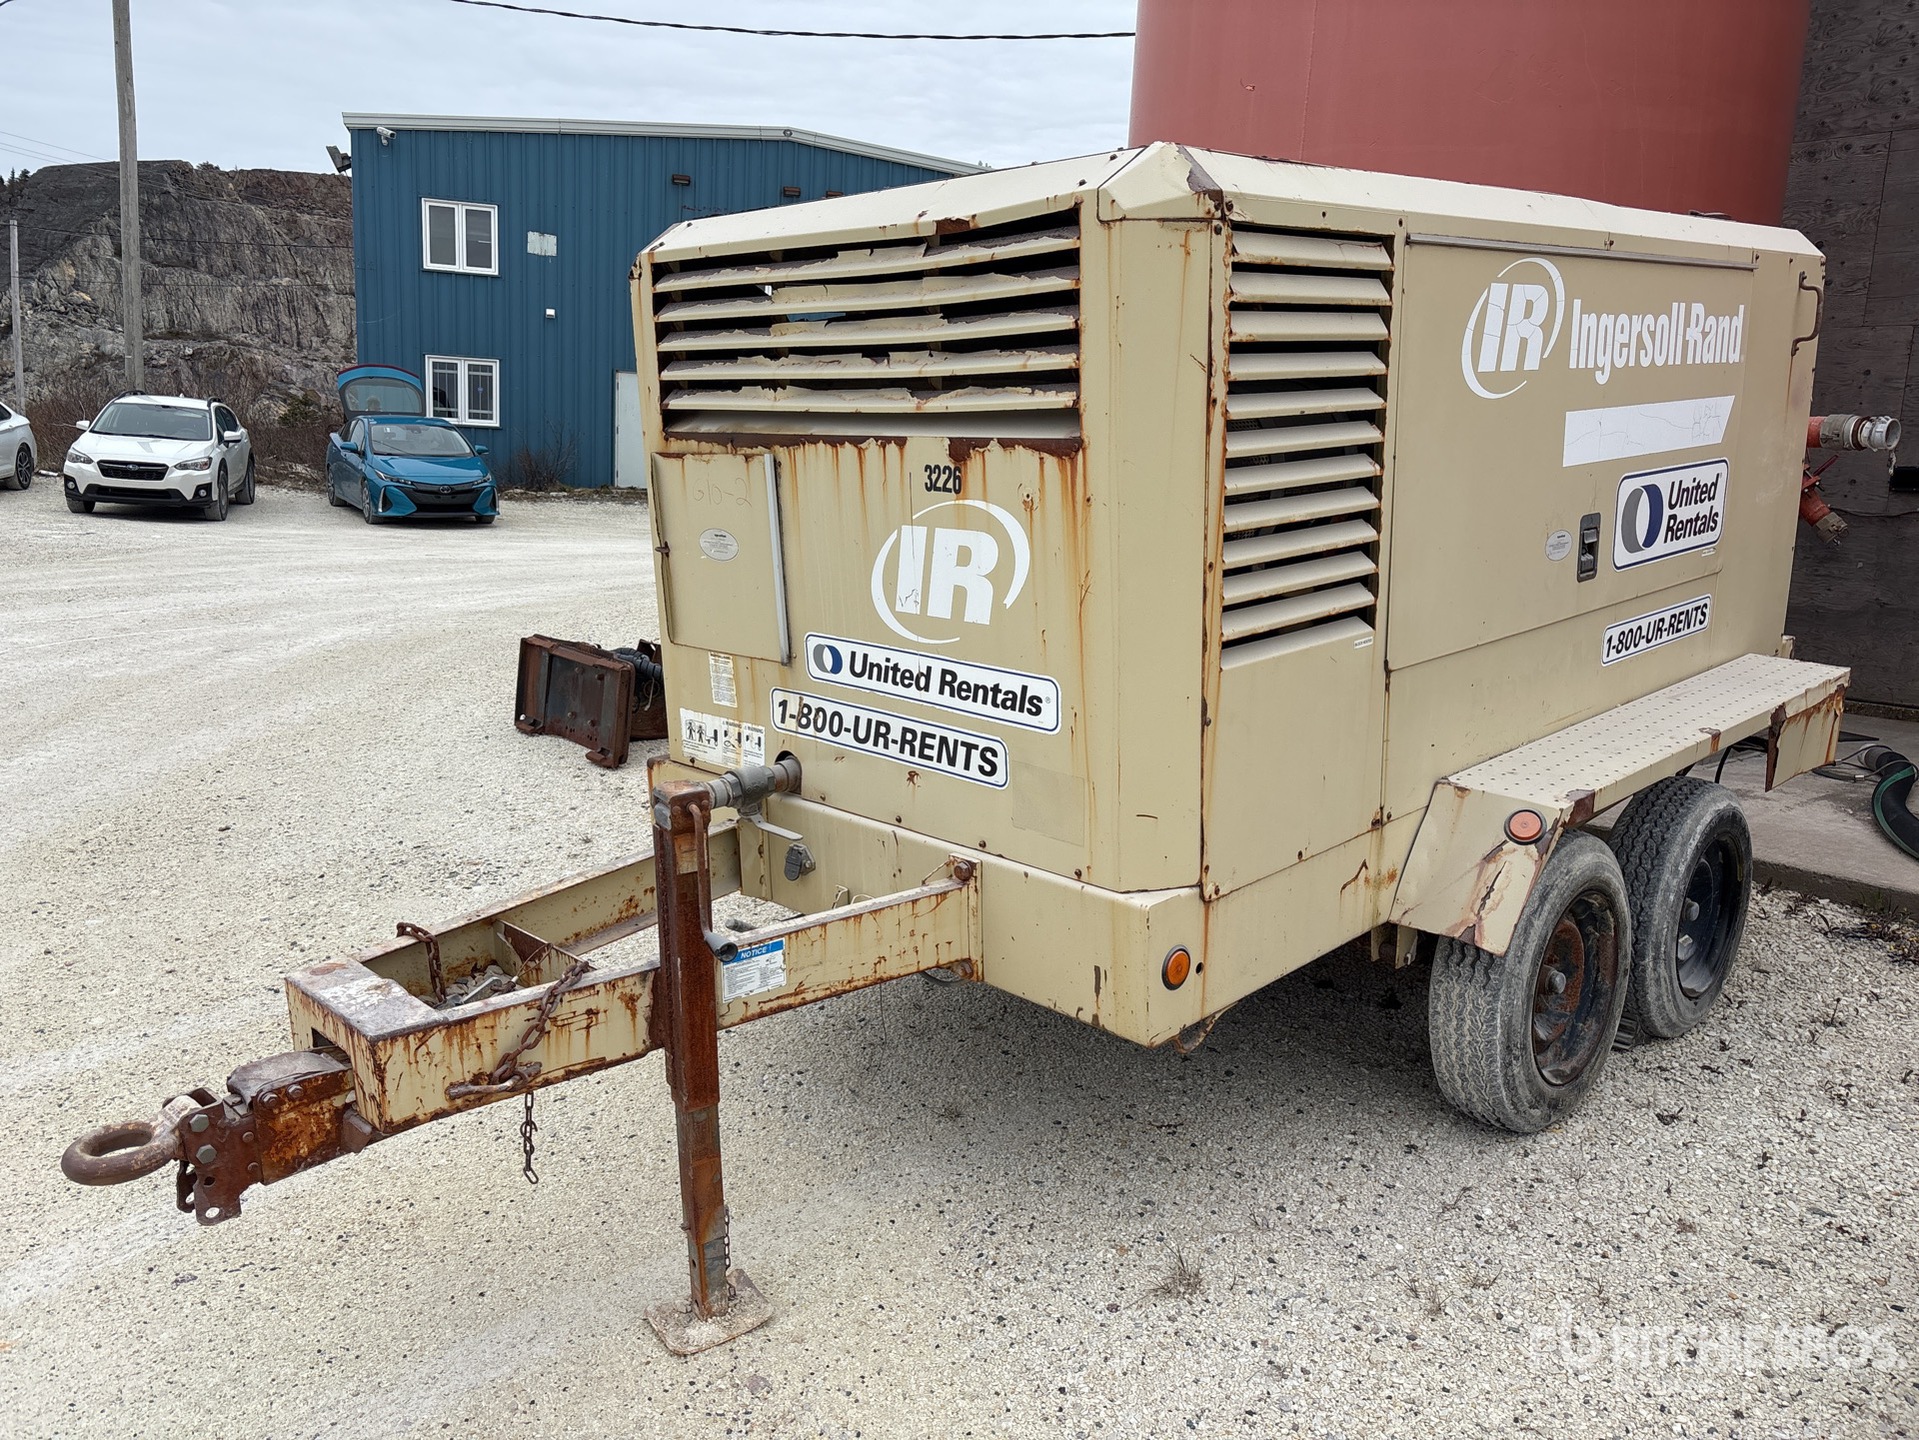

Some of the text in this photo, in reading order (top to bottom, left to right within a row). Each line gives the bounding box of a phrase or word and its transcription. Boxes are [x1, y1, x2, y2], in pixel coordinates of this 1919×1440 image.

[924, 463, 962, 495] 3226
[1667, 473, 1720, 511] United
[1664, 500, 1719, 544] Rentals
[1606, 602, 1708, 659] 1-800-UR-RENTS
[848, 650, 930, 692] United
[777, 699, 999, 778] 1-800-UR-RENTS
[740, 946, 768, 959] NOTICE
